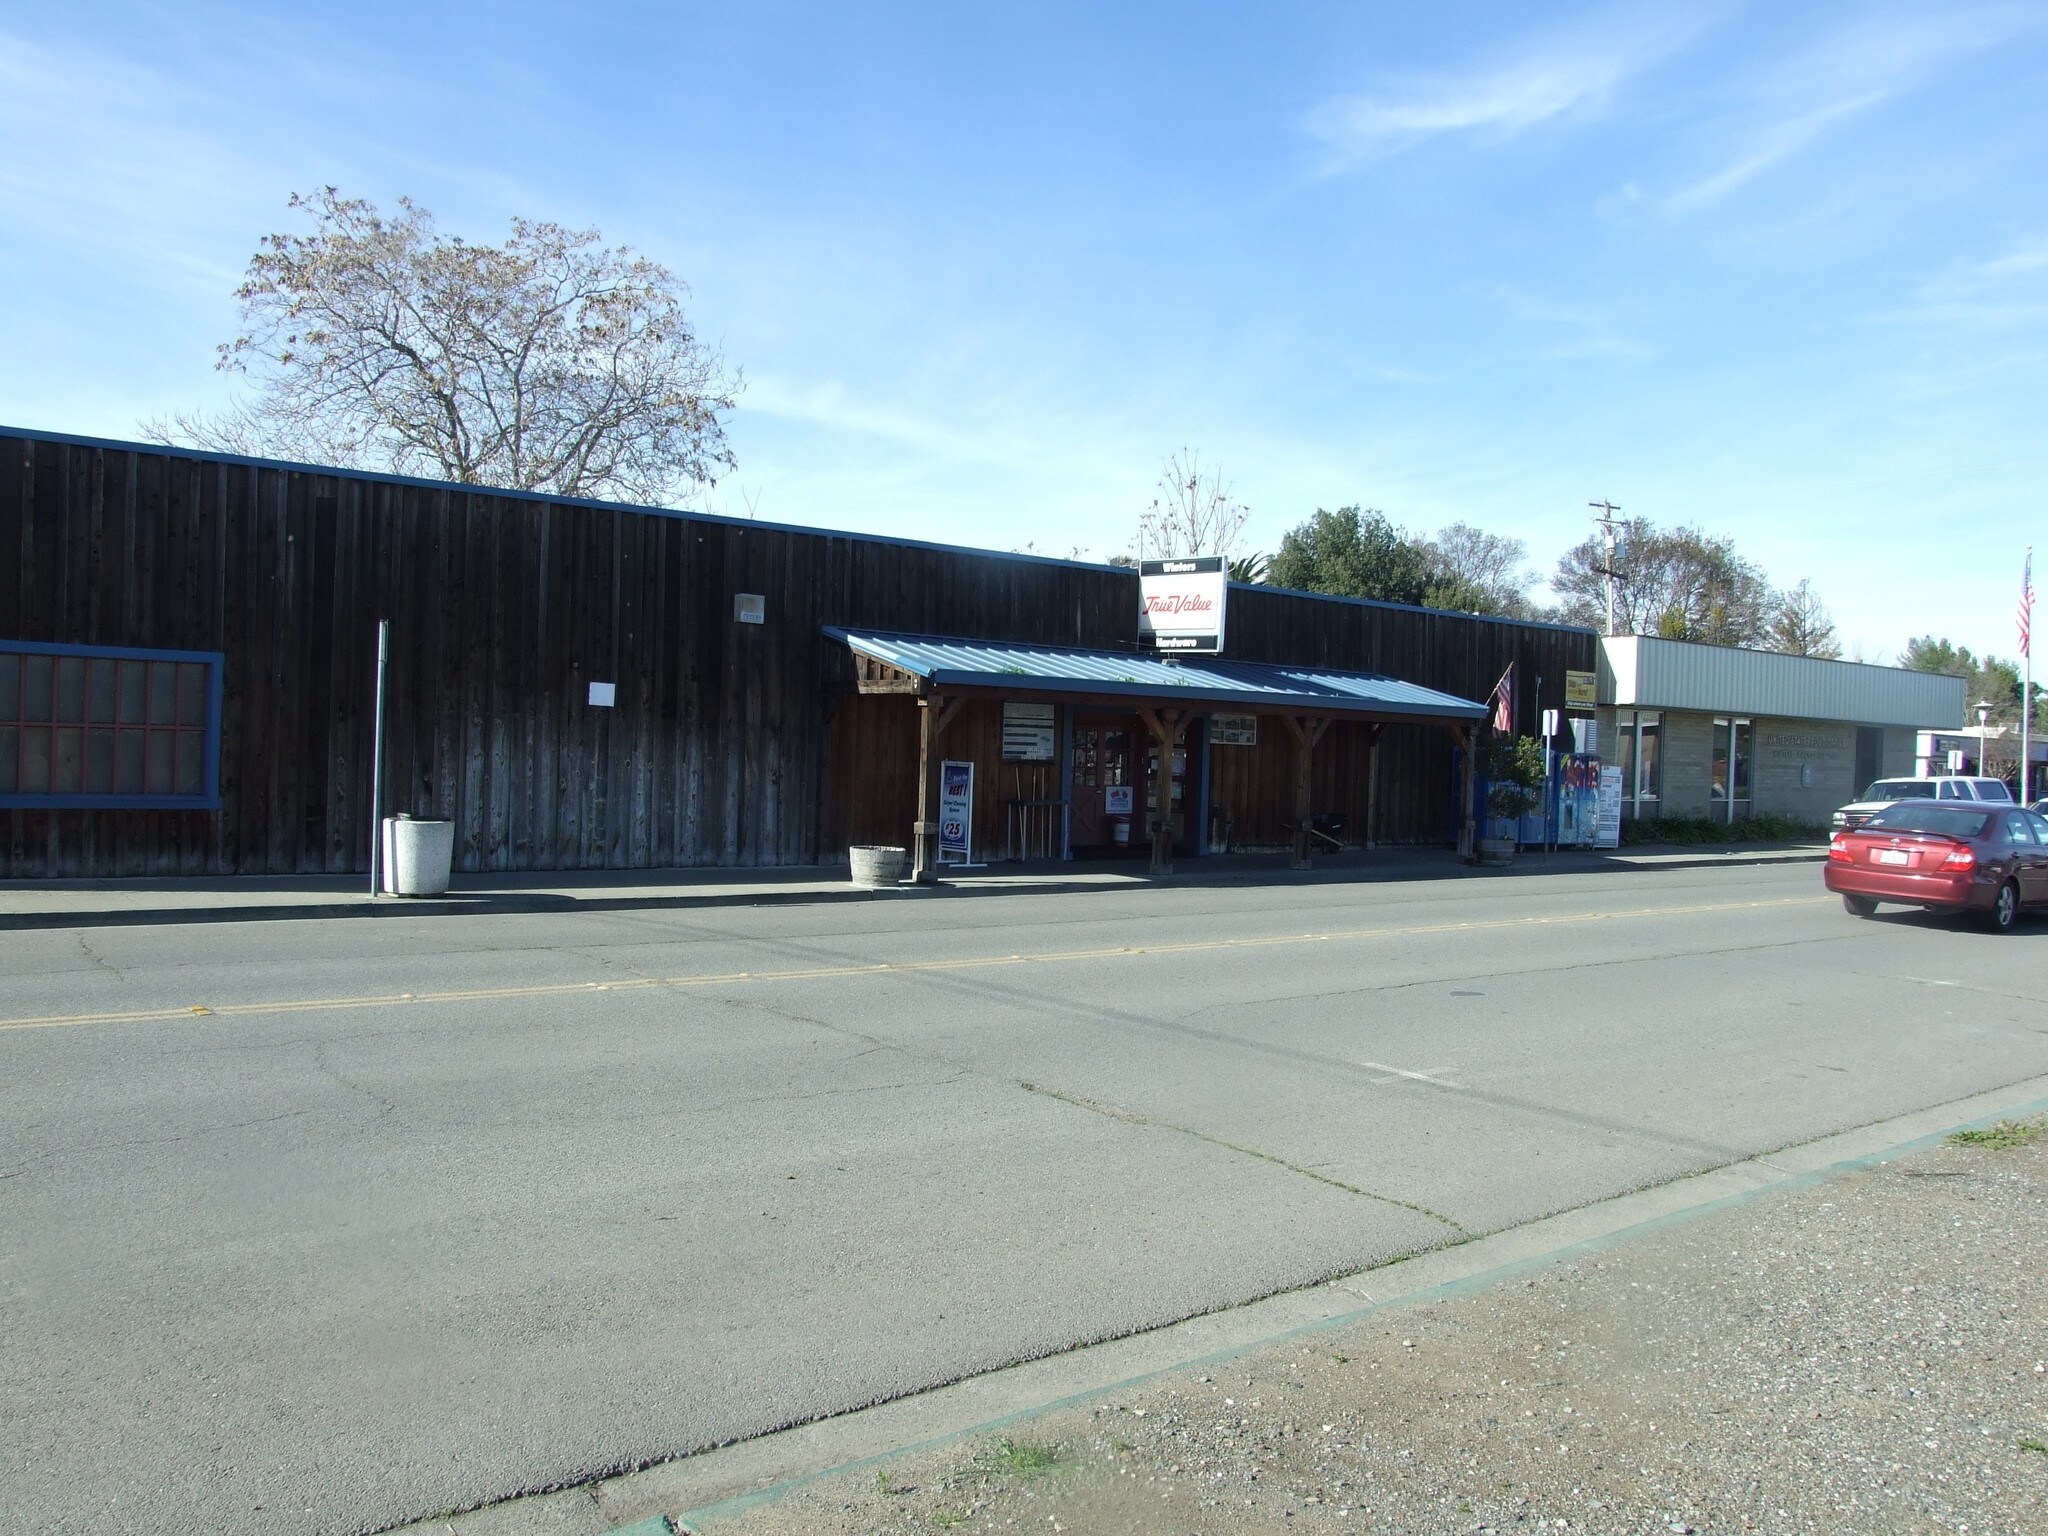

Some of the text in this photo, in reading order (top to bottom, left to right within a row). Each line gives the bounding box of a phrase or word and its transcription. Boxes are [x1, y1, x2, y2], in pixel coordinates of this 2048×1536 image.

[1141, 594, 1212, 616] True Value
[945, 822, 960, 836] $25
